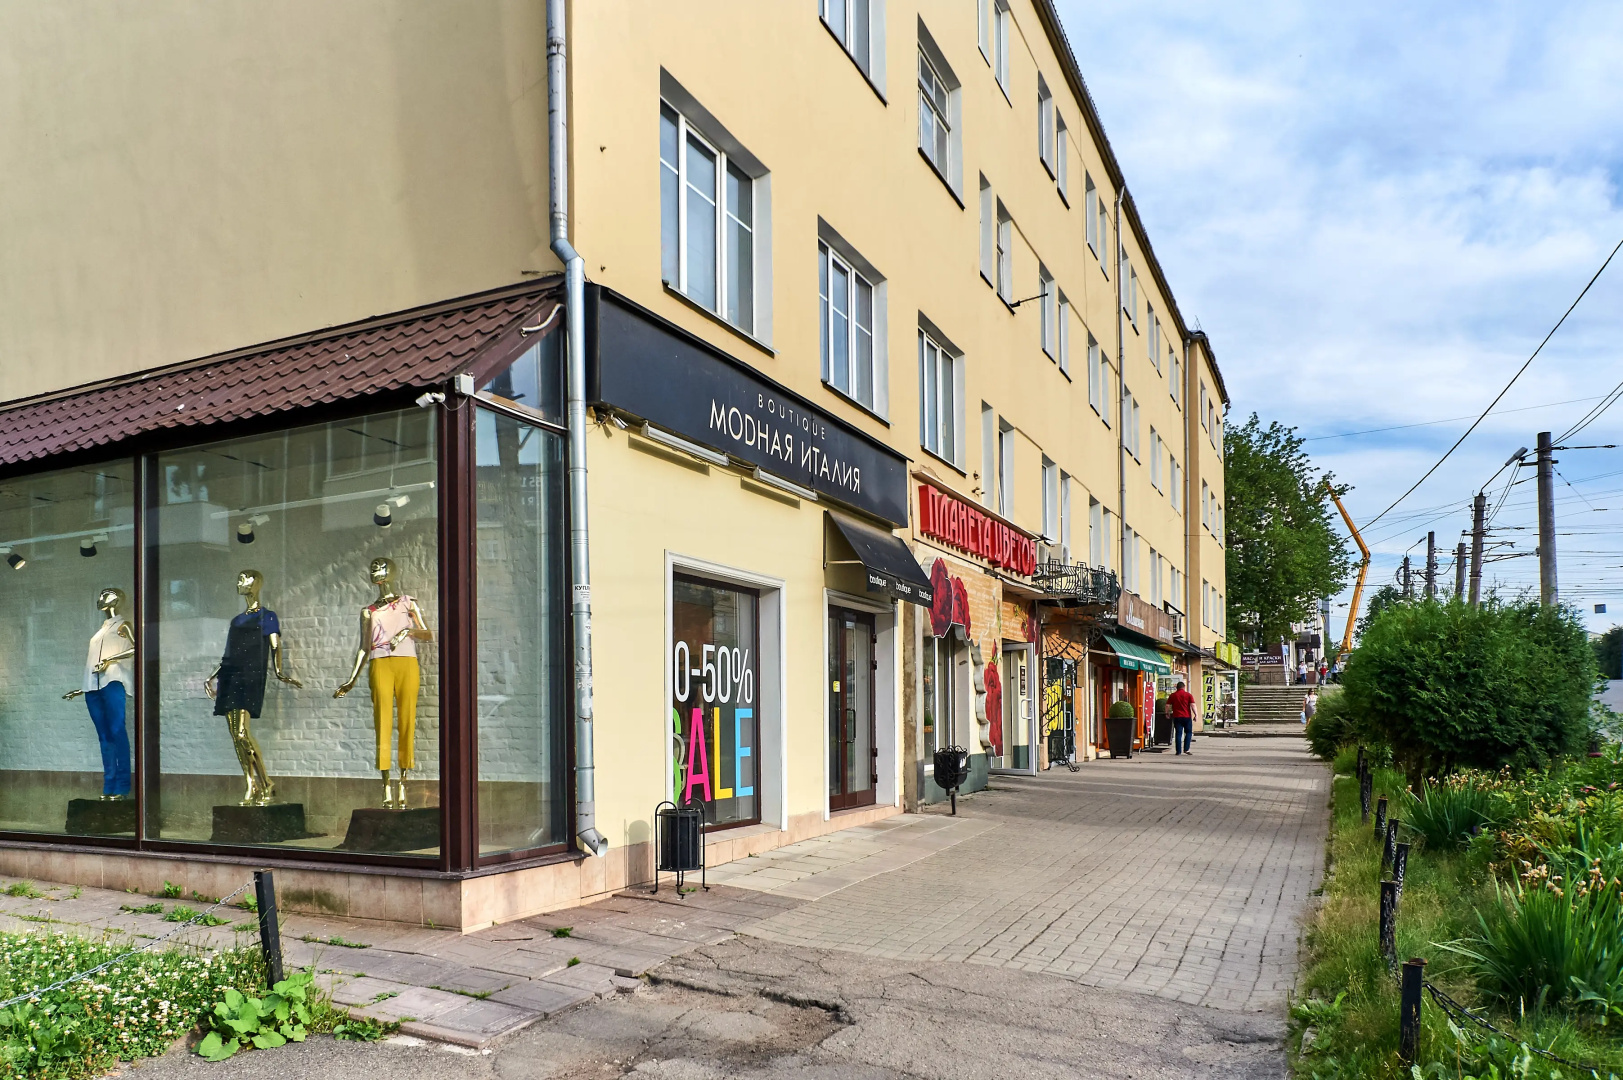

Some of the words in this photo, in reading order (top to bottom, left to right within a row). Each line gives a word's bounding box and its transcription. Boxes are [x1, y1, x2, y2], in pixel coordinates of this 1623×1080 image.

[758, 393, 825, 440] BOUTIQUE
[801, 441, 860, 494] ИТАЛИЯ
[922, 484, 993, 559] ПЛАНЕТА
[993, 520, 1037, 577] ЦВЕТОВ
[869, 573, 887, 588] boutique
[895, 581, 911, 595] boutique
[918, 588, 932, 602] boutique
[1205, 676, 1214, 720] ЦВЕТЫ
